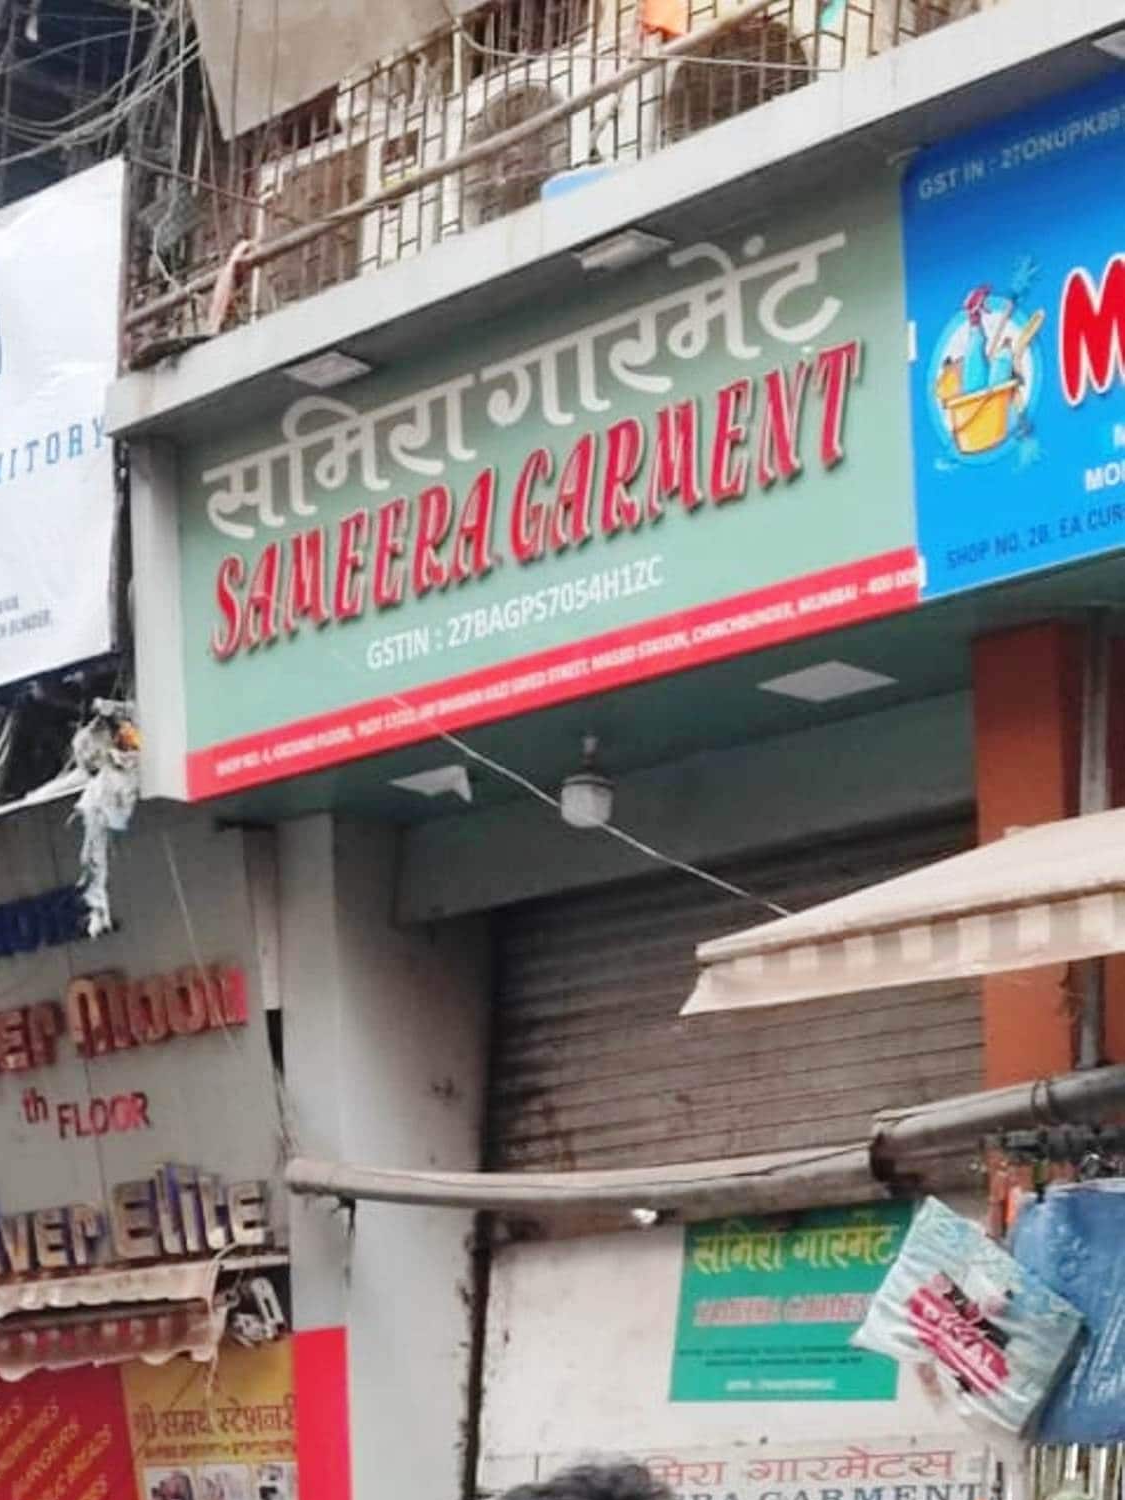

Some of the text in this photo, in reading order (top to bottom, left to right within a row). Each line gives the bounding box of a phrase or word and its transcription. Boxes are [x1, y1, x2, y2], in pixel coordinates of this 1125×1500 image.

[203, 232, 846, 540] समिरा गारमेंट
[210, 340, 862, 664] SAMEERA GARMENT
[366, 627, 430, 669] GSTIN
[21, 1087, 150, 1139] th FLOOR
[643, 1455, 727, 1488] मिरा
